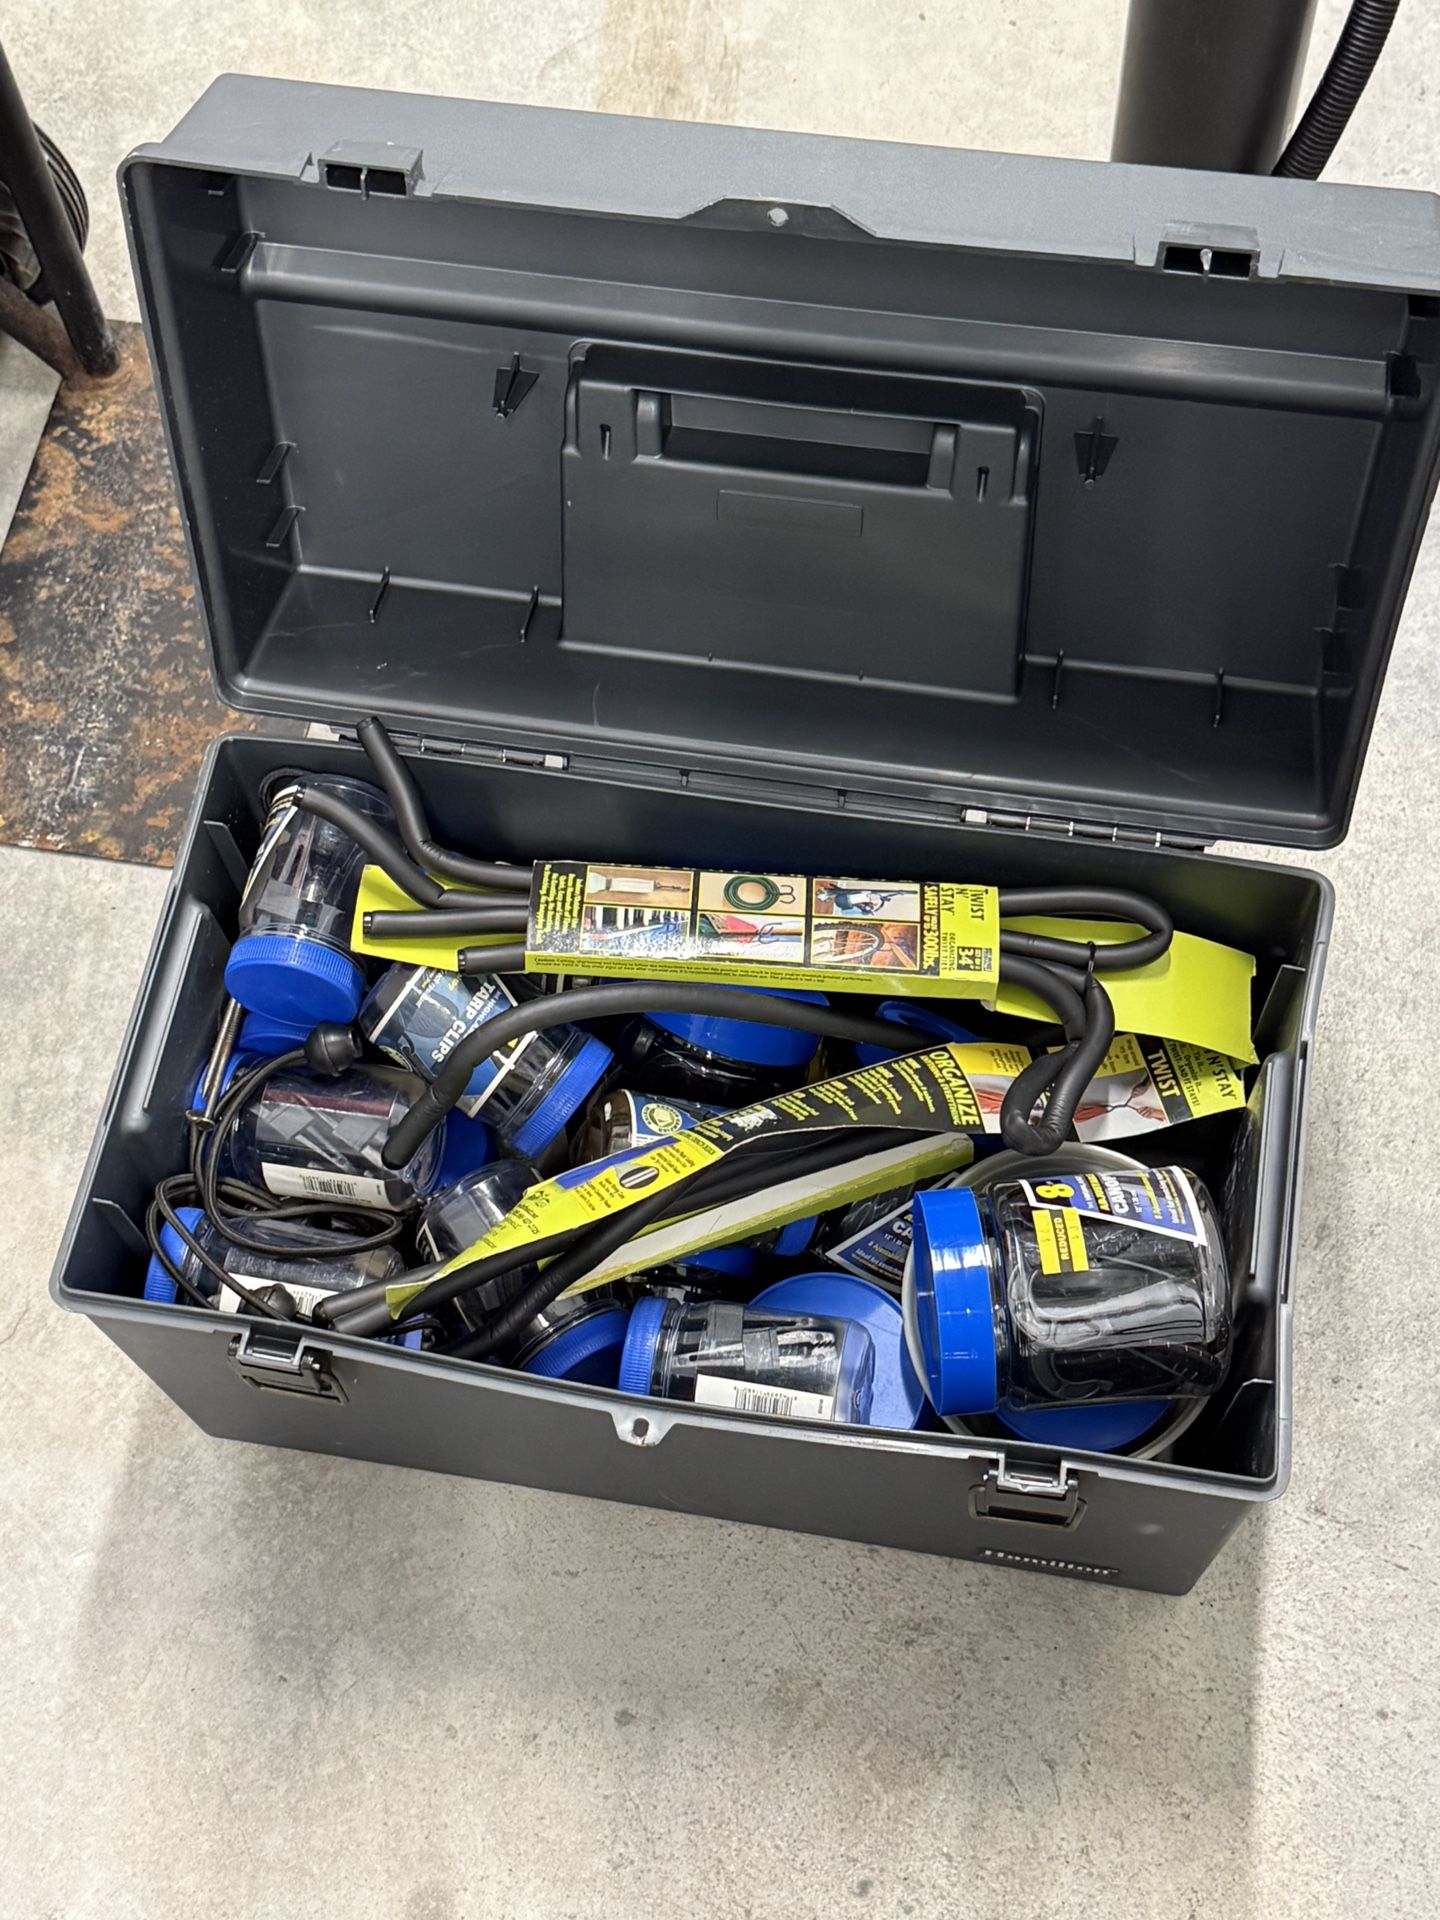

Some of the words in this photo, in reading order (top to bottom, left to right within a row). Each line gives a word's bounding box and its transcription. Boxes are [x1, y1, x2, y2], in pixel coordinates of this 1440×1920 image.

[924, 886, 938, 916] SAFELY
[970, 888, 988, 920] TWIST
[466, 982, 496, 1020] TARP
[431, 1020, 466, 1062] CLIPS
[929, 1052, 980, 1126] ORGANIZE
[1148, 1049, 1181, 1098] TWIST
[1036, 1183, 1075, 1199] 8
[1054, 1217, 1070, 1260] REDUCED
